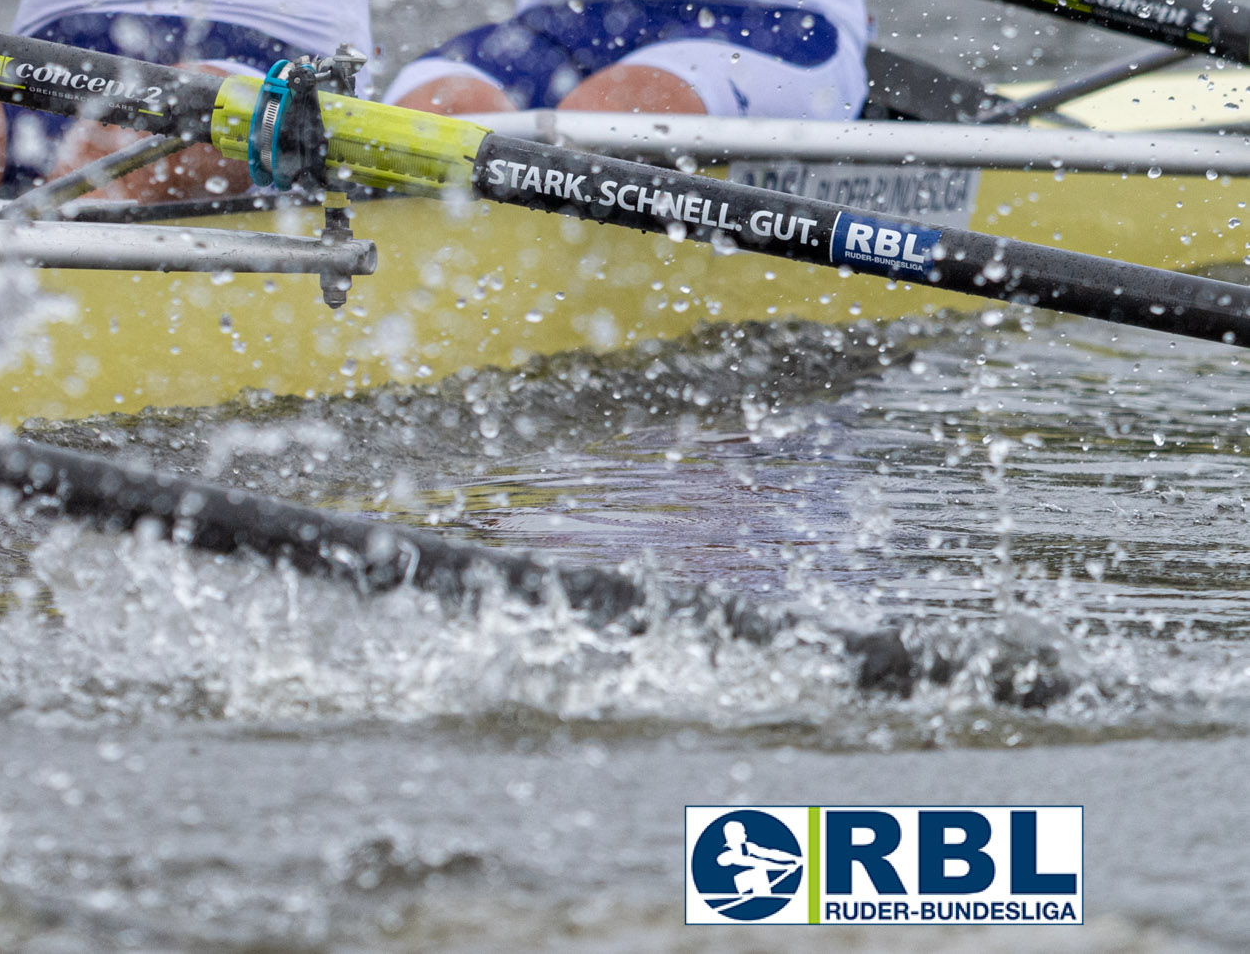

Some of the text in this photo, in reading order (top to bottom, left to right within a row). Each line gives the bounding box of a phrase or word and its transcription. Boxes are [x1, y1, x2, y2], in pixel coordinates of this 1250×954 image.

[15, 62, 164, 104] concept 2
[488, 159, 592, 202] STARK.
[598, 180, 743, 232] SCHNELL.
[750, 210, 819, 247] GUT.
[844, 250, 924, 272] RUDER-BUNDESLIGA
[845, 222, 925, 264] RBL
